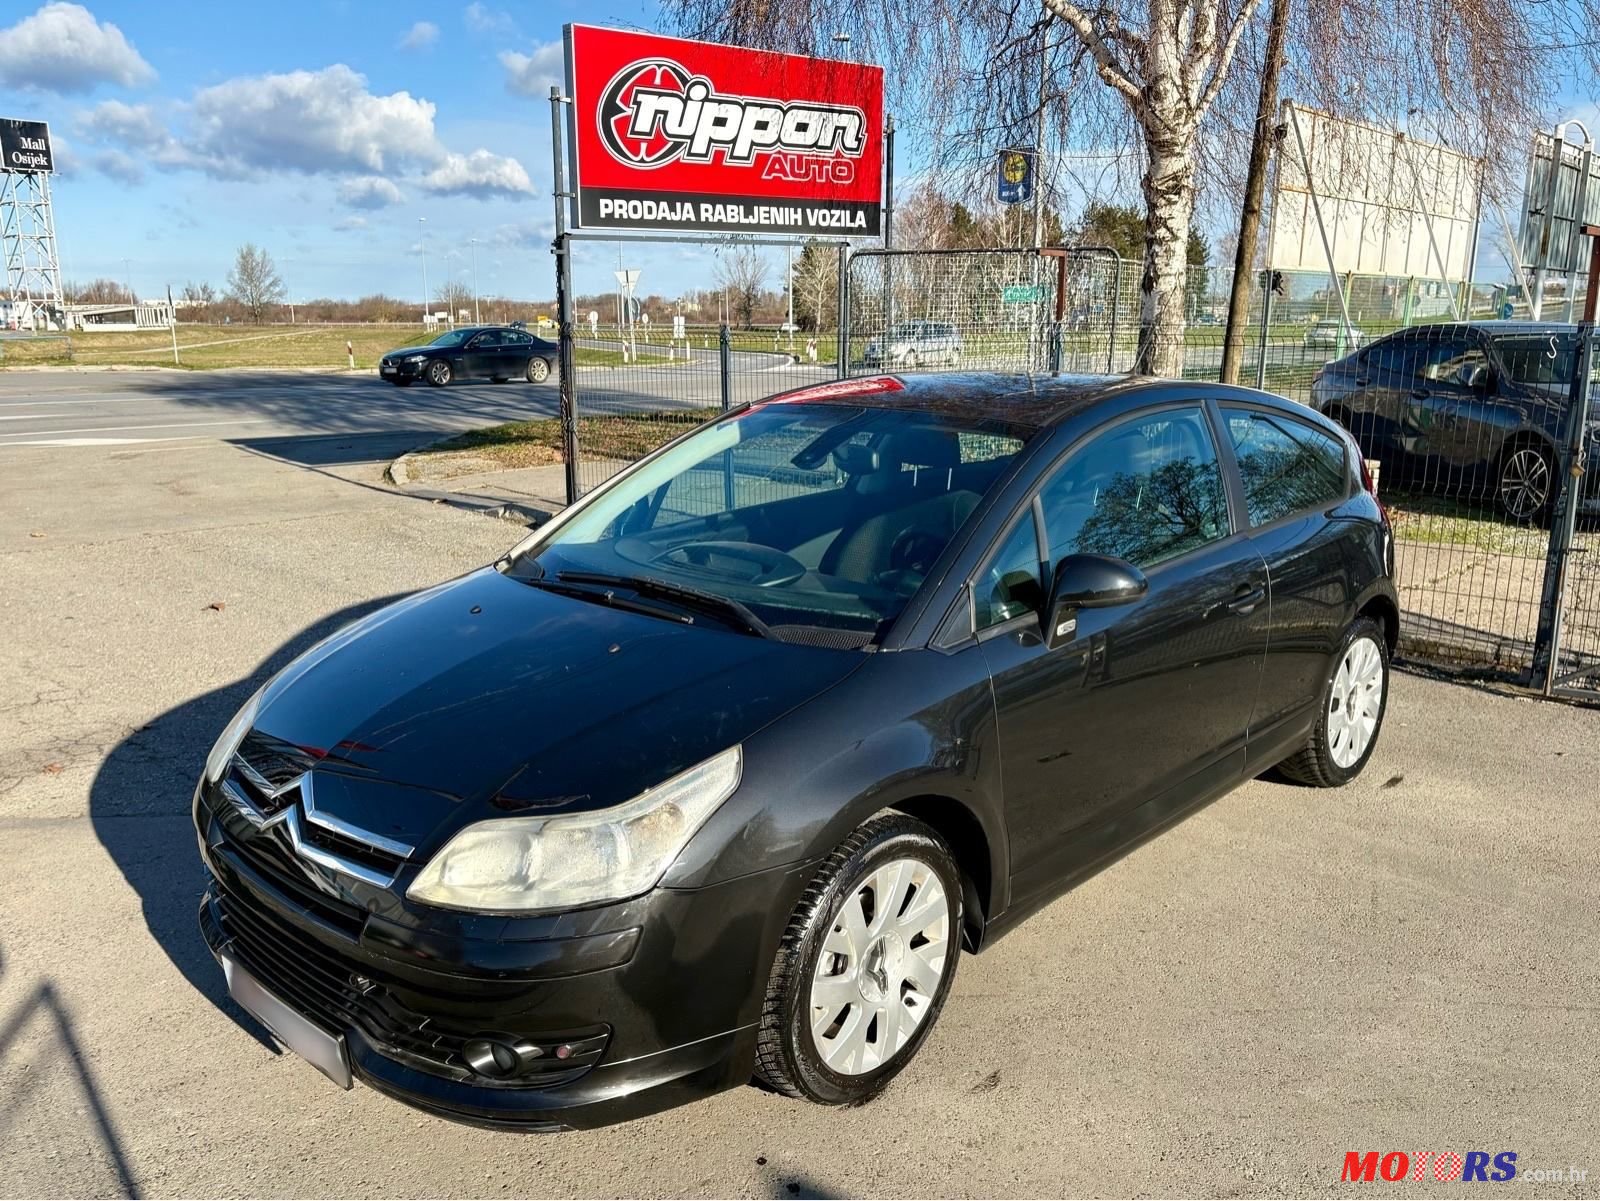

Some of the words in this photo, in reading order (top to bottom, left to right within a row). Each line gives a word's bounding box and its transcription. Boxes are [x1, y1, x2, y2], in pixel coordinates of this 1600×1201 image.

[630, 81, 862, 160] nippon
[20, 136, 46, 151] Mall
[12, 151, 48, 168] Osijek
[761, 152, 855, 184] AUTO
[599, 198, 696, 222] PRODAJA
[700, 203, 803, 227] RABLJENIH
[807, 209, 867, 229] VOZILA
